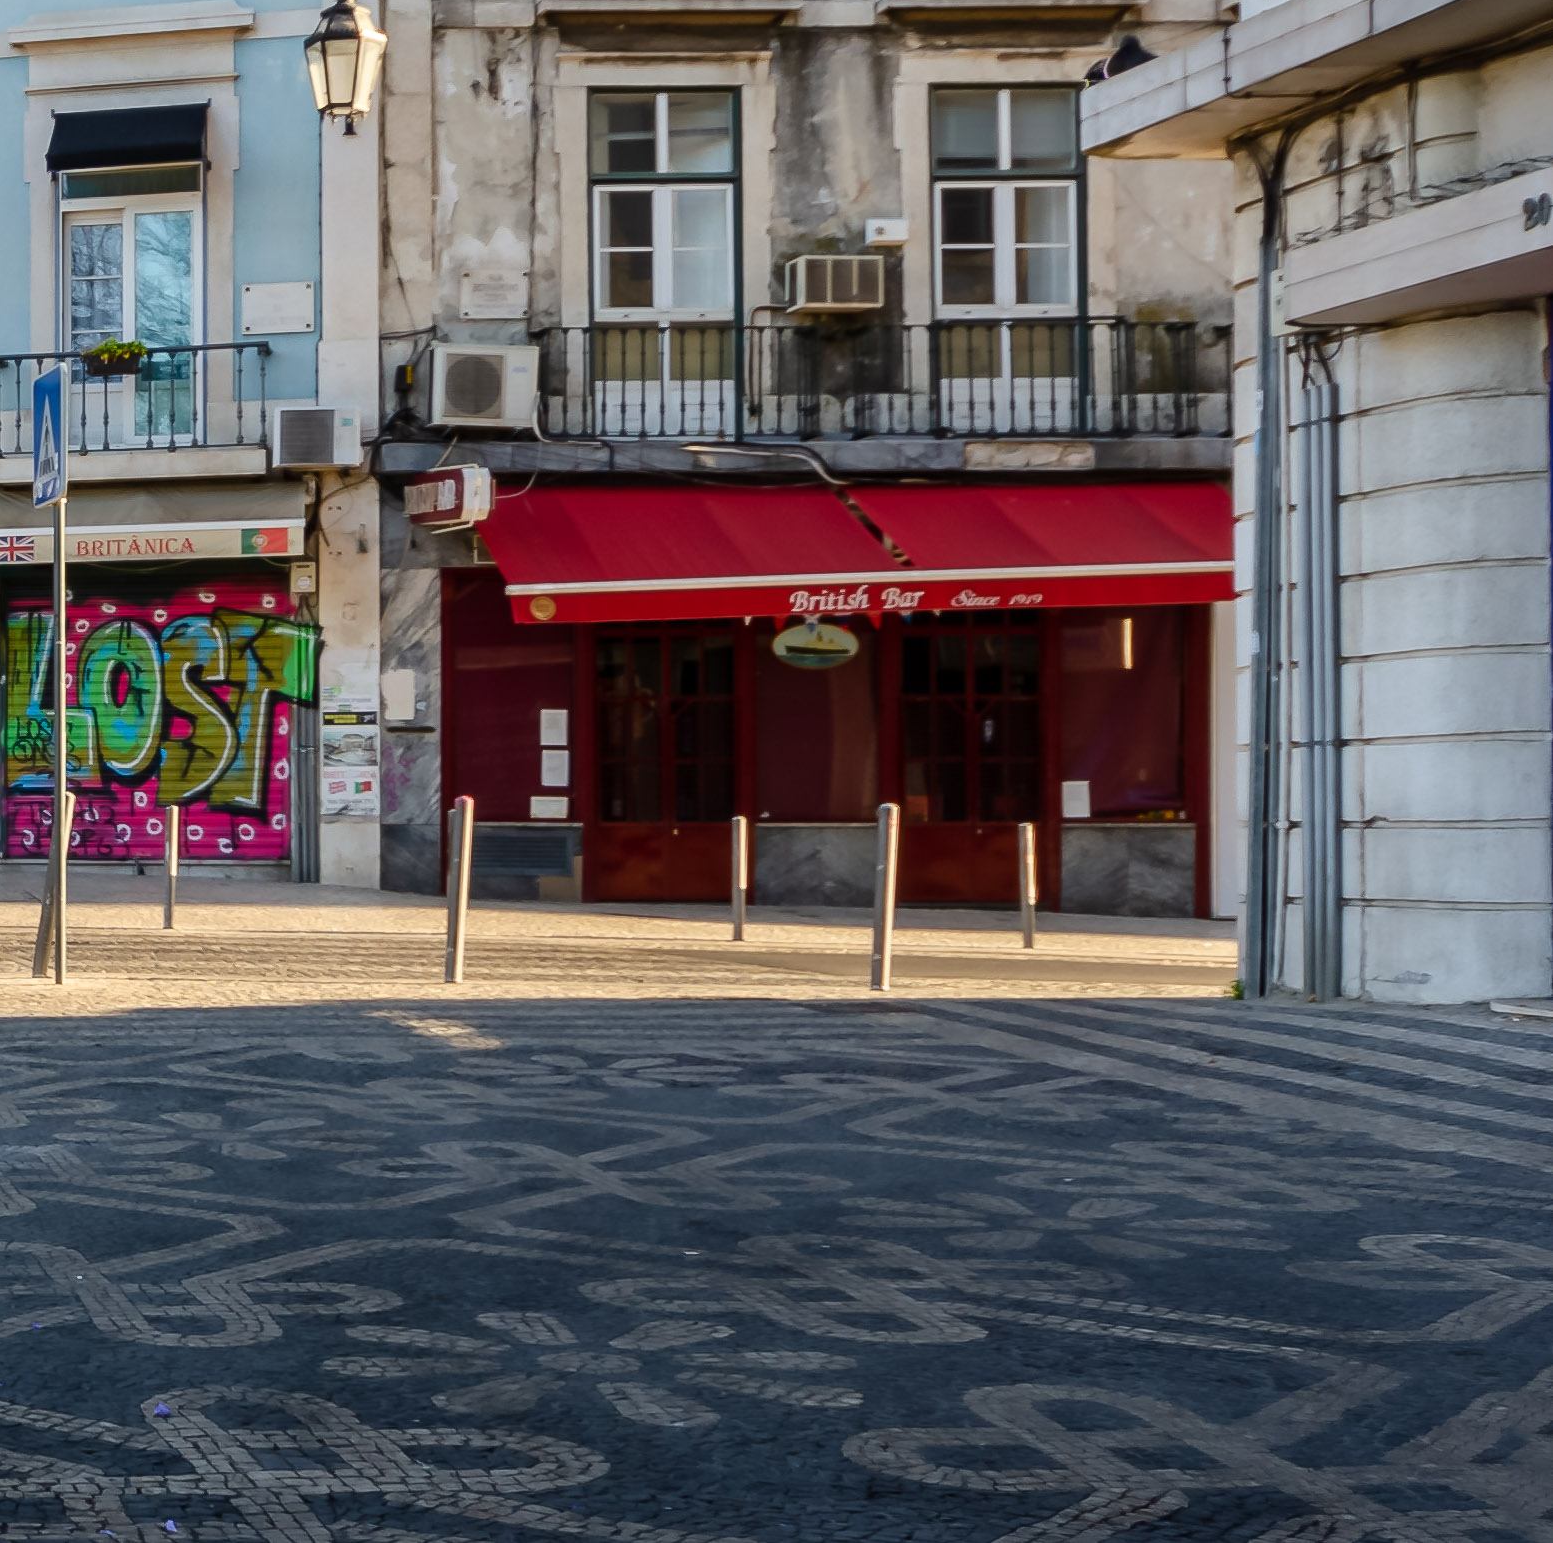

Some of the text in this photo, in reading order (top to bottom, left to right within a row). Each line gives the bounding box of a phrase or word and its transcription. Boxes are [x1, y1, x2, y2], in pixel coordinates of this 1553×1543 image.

[76, 535, 195, 557] BRITÂNICA
[790, 584, 870, 612] British
[881, 587, 925, 609] Bar
[950, 589, 1000, 608] Since
